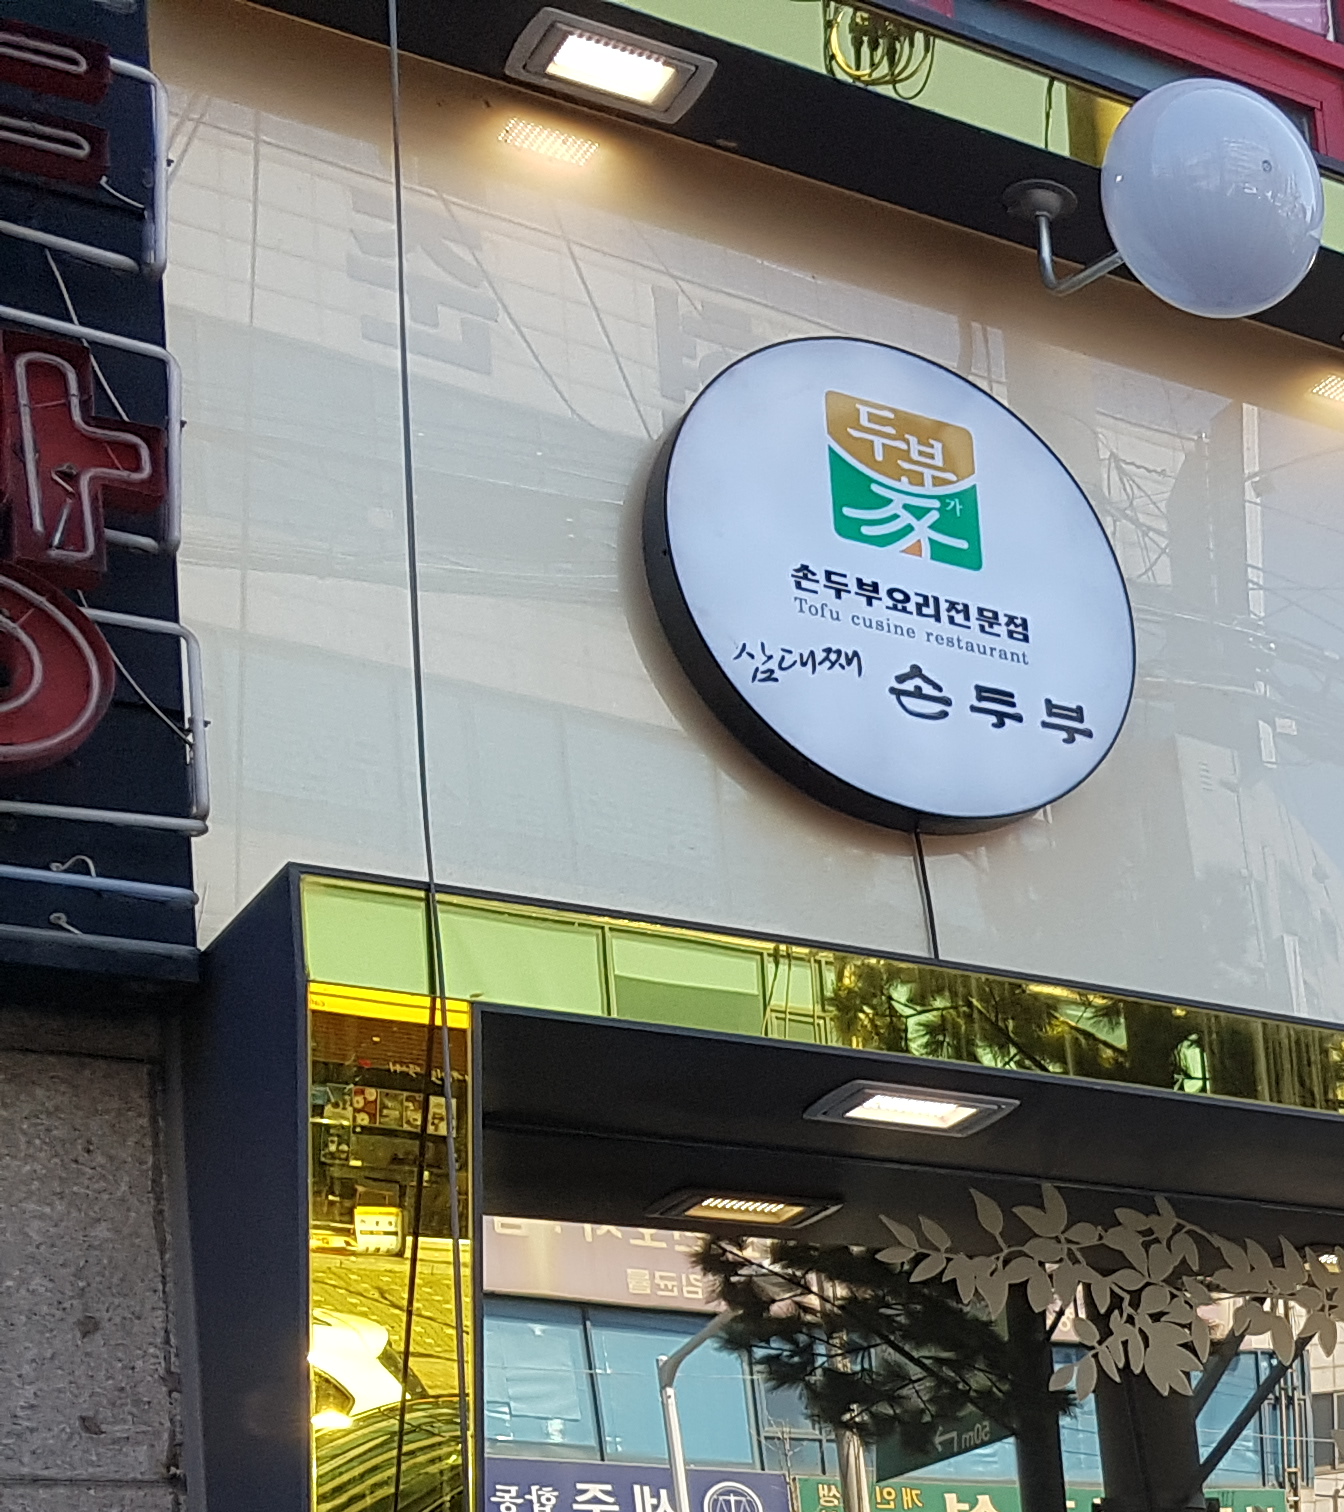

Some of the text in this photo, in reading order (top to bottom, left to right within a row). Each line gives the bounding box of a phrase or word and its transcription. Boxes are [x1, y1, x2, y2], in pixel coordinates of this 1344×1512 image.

[847, 403, 957, 490] 두부
[791, 563, 1030, 644] 손두부요리전문점
[794, 596, 1030, 665] Tofu cusine restaurant
[732, 641, 1094, 744] 삼대째 손두부
